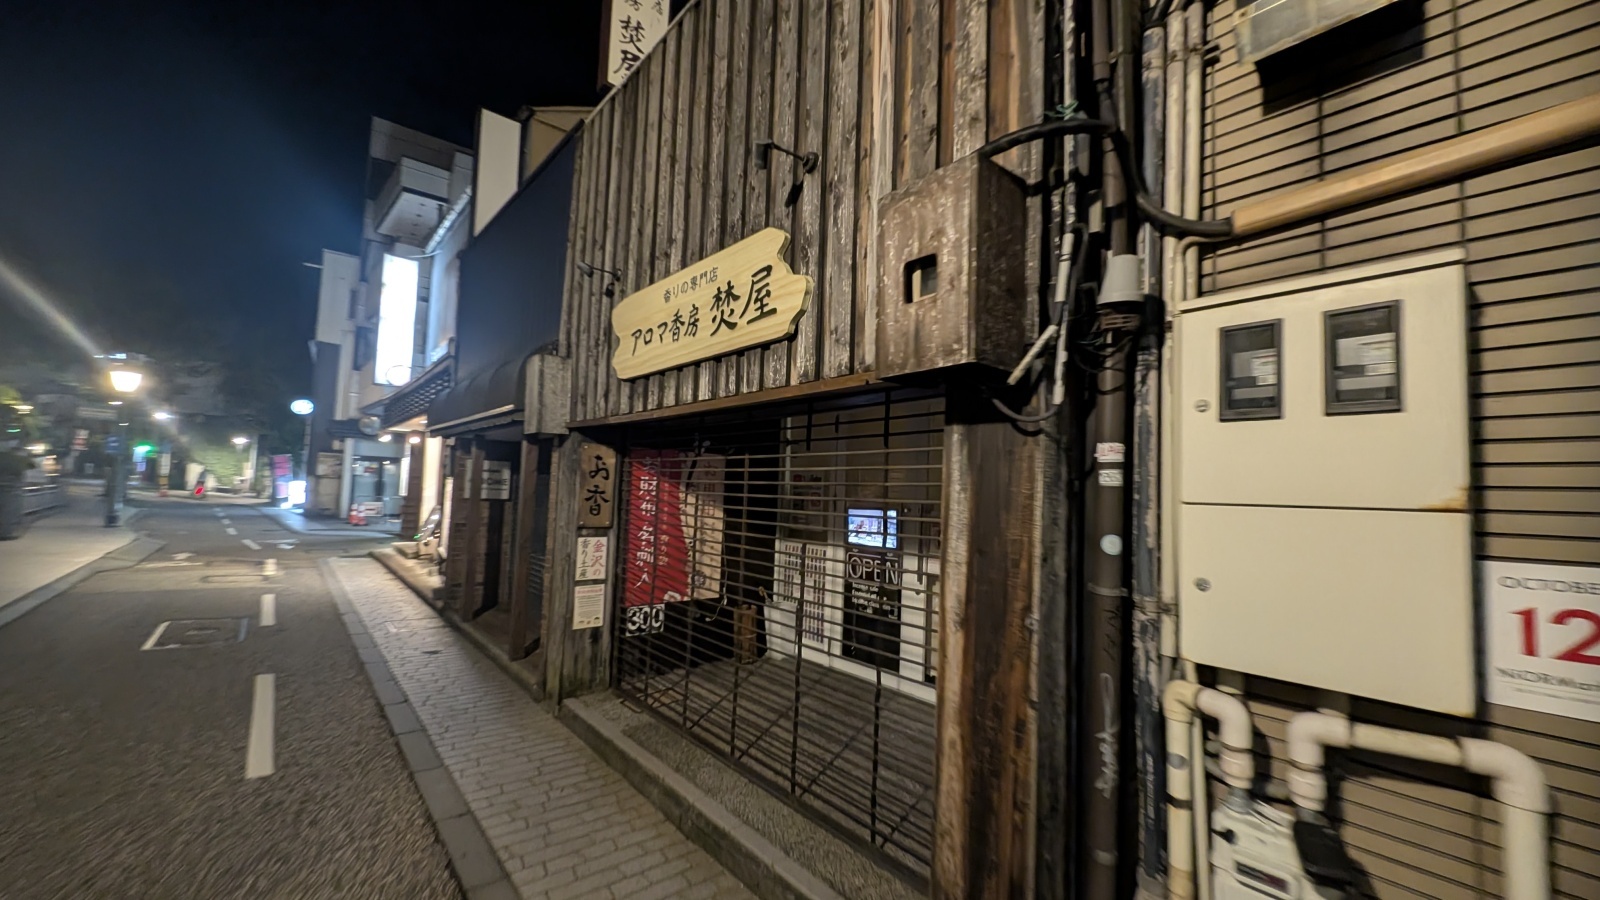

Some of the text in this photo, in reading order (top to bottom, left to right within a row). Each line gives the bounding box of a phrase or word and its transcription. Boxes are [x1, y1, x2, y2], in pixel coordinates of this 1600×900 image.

[663, 267, 718, 303] 香りの専門店
[631, 264, 777, 356] アロマ香房 焚屋
[584, 455, 610, 516] お香
[590, 539, 605, 576] 金沢の
[850, 557, 898, 585] OPEN
[627, 606, 664, 631] 300
